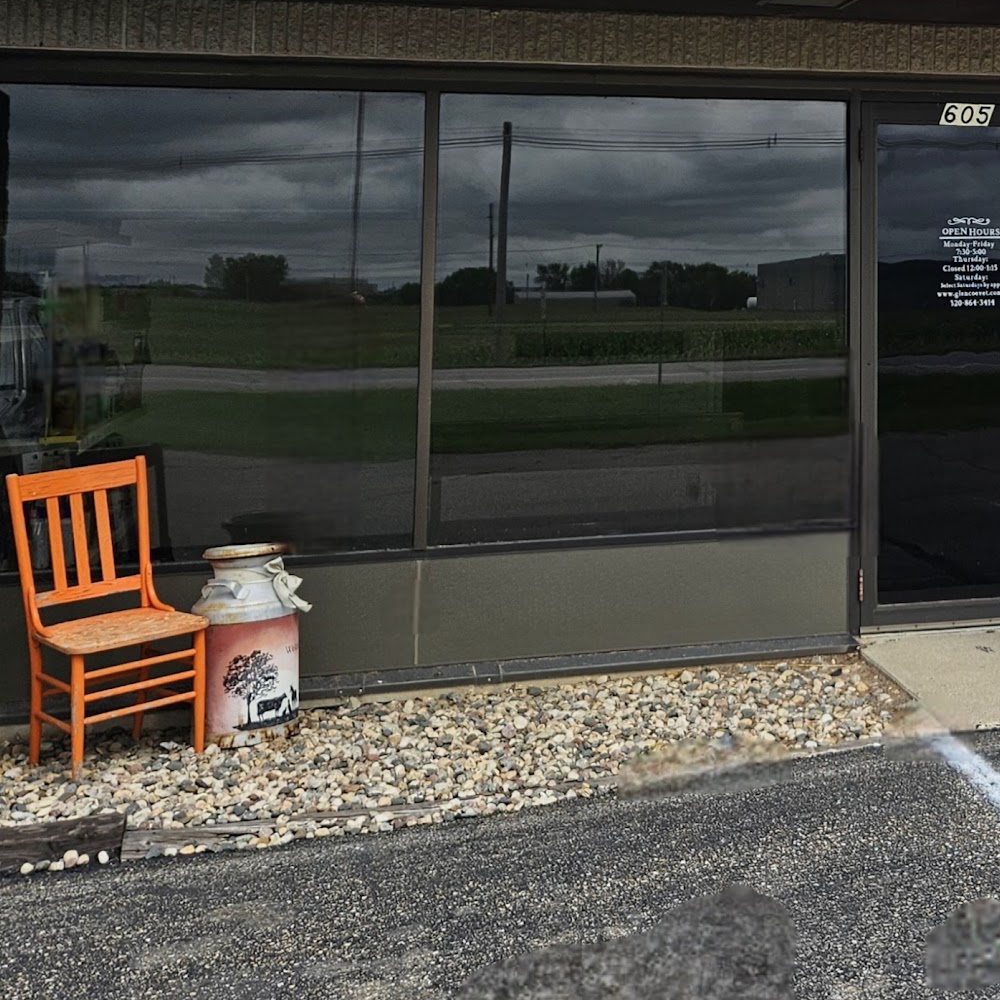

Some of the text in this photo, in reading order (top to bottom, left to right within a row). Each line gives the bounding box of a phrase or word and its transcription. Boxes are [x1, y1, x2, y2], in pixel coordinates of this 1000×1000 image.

[944, 104, 991, 125] 605
[941, 227, 1000, 236] OPEN HOURS
[953, 255, 989, 264] Thursday:
[942, 264, 966, 272] Closed
[954, 273, 988, 282] Saturday:
